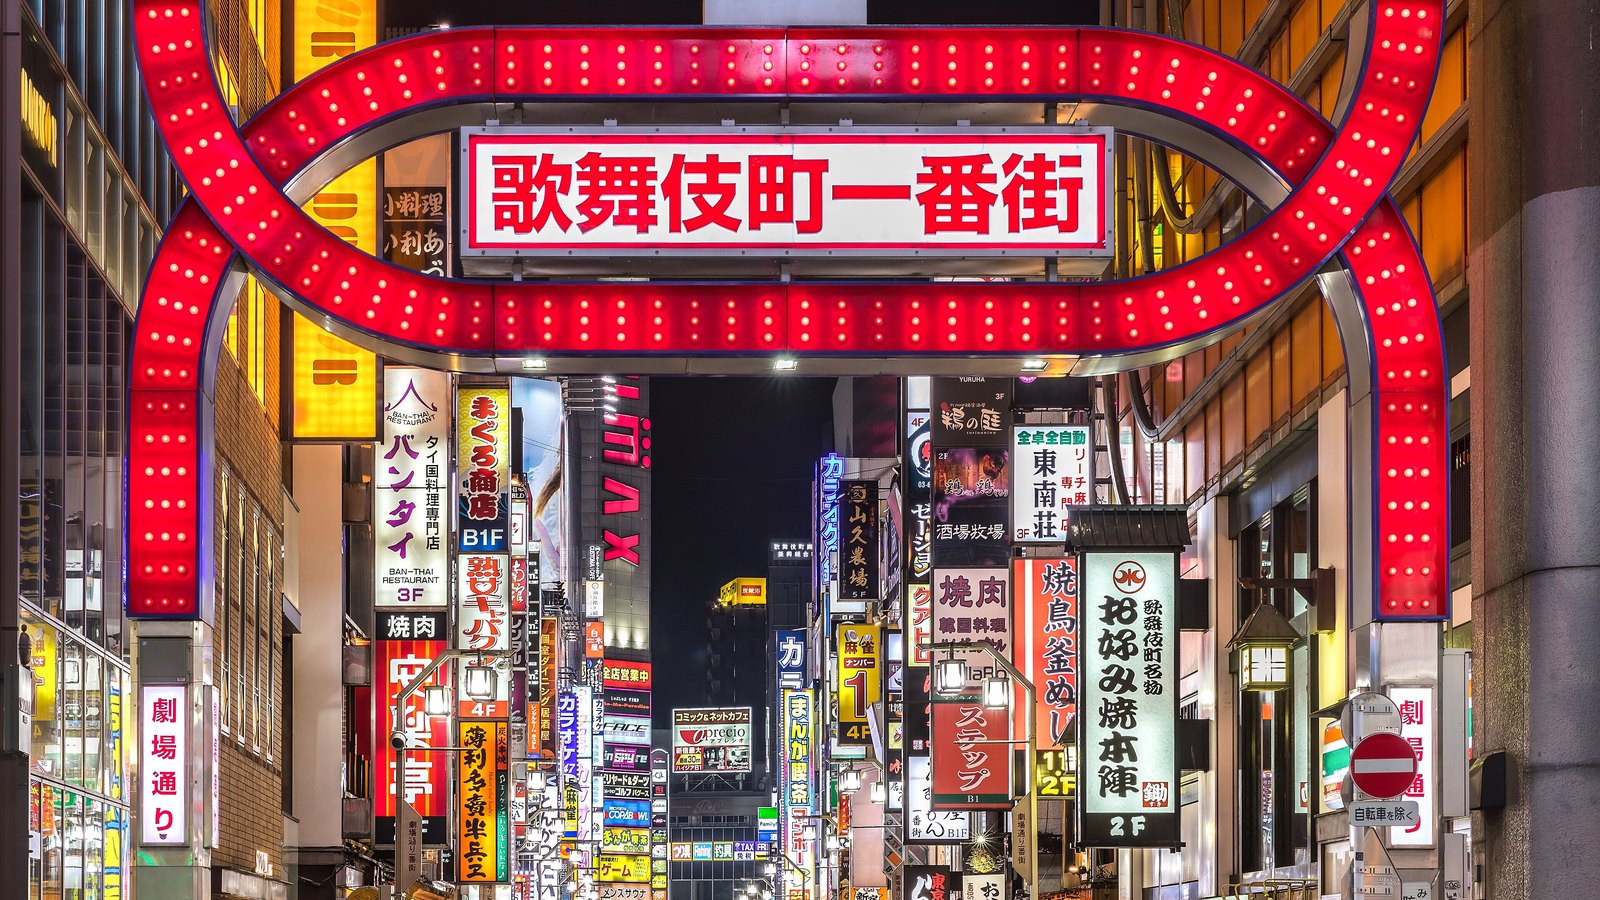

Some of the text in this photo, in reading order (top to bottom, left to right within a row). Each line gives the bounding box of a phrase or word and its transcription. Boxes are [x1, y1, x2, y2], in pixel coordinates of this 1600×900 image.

[491, 151, 1083, 235] 歌舞伎町一番街
[386, 414, 438, 426] RESTAURANT
[392, 410, 430, 419] BAN-THAI
[911, 418, 924, 426] 4F
[1017, 431, 1086, 446] 全卓全自動
[469, 395, 499, 520] まぐろ商店
[384, 434, 420, 559] バンタイ
[426, 435, 440, 550] タイ国料理専門店
[1032, 448, 1058, 538] 東南荘
[463, 528, 504, 546] B1F
[936, 524, 1005, 540] 酒場牧場
[1016, 528, 1030, 539] 3F
[848, 506, 868, 586] 山久農場
[397, 588, 424, 602] 3F
[939, 575, 1007, 608] 焼肉
[387, 614, 436, 638] 焼肉
[939, 617, 1007, 634] 韓国料理
[1042, 561, 1076, 742] 焼鳥釜めし
[1143, 600, 1163, 696] 歌舞伎町名物
[603, 666, 648, 683] 全店営業中
[845, 670, 867, 718] 1
[1098, 595, 1139, 798] お好み焼本陣
[471, 704, 496, 717] 4F
[676, 712, 748, 722] コミック&ネットカフェ
[846, 726, 871, 739] 4F
[791, 697, 808, 804] まんが喫茶
[955, 706, 991, 792] ステップ
[150, 698, 177, 831] 劇場通り
[1042, 776, 1075, 795] 2F
[912, 810, 922, 837] 一番街
[1354, 807, 1413, 821] 自転車を除く
[948, 829, 967, 838] B1F
[1110, 816, 1146, 836] 2F
[602, 830, 648, 846] まんが喫茶
[1017, 813, 1026, 864] 劇場通り一番街
[602, 864, 631, 876] ゲーム
